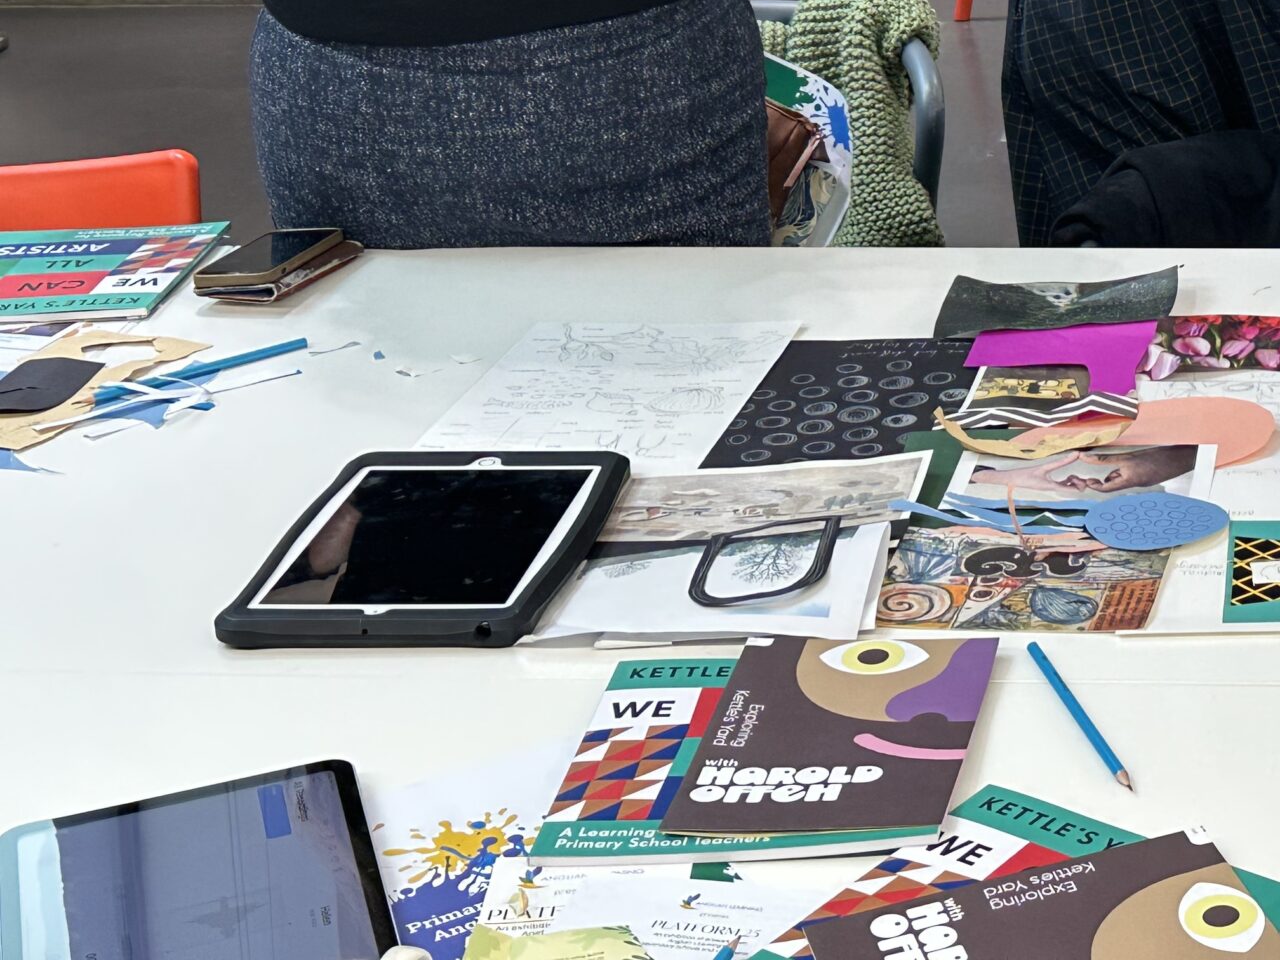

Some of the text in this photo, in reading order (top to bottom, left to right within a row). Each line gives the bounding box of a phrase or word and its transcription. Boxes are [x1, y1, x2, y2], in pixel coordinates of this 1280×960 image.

[0, 243, 110, 256] ARTISTS
[46, 258, 94, 269] ALL
[17, 280, 86, 292] CAN
[112, 278, 158, 288] WE
[44, 296, 141, 309] KETTLE'S
[629, 665, 731, 680] KETTLE
[612, 700, 676, 719] WE
[712, 689, 750, 747] Kettle's Yard
[730, 703, 764, 747] Exploring
[705, 758, 738, 767] with
[696, 765, 883, 785] HAROLD
[979, 796, 1100, 845] KETTLE'S
[558, 827, 655, 839] A Learning
[554, 838, 624, 851] Primary
[629, 836, 688, 848] School
[927, 831, 993, 866] WE
[983, 861, 1095, 899] Kettle's Yard
[989, 880, 1078, 910] Exploring
[944, 897, 965, 921] with
[651, 919, 741, 937] PLATFORM
